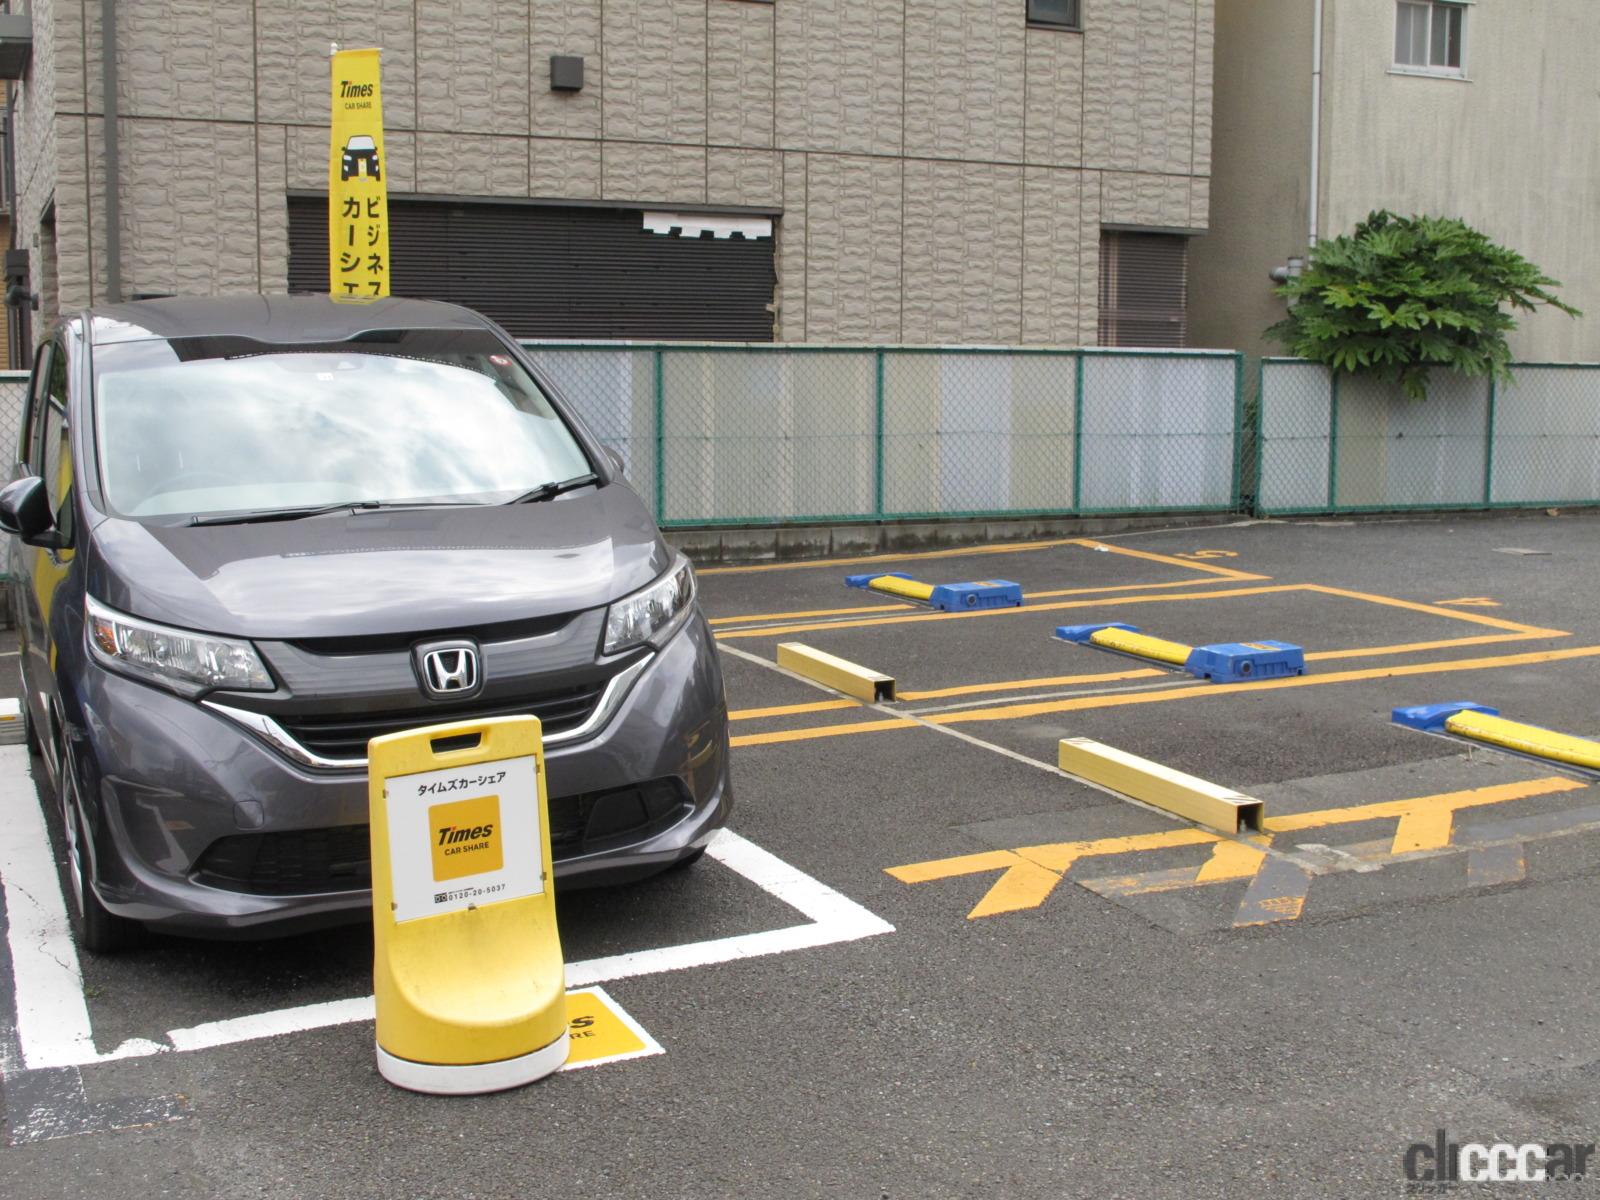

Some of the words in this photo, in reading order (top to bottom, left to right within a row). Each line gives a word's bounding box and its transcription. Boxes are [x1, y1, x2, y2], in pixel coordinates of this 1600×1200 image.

[340, 80, 374, 98] Times
[344, 102, 356, 110] CAR
[418, 771, 506, 796] タイムズカーシェア
[438, 824, 493, 846] Times
[444, 847, 461, 856] CAR
[463, 841, 489, 853] SHARE
[448, 883, 506, 901] 0120-20-5037
